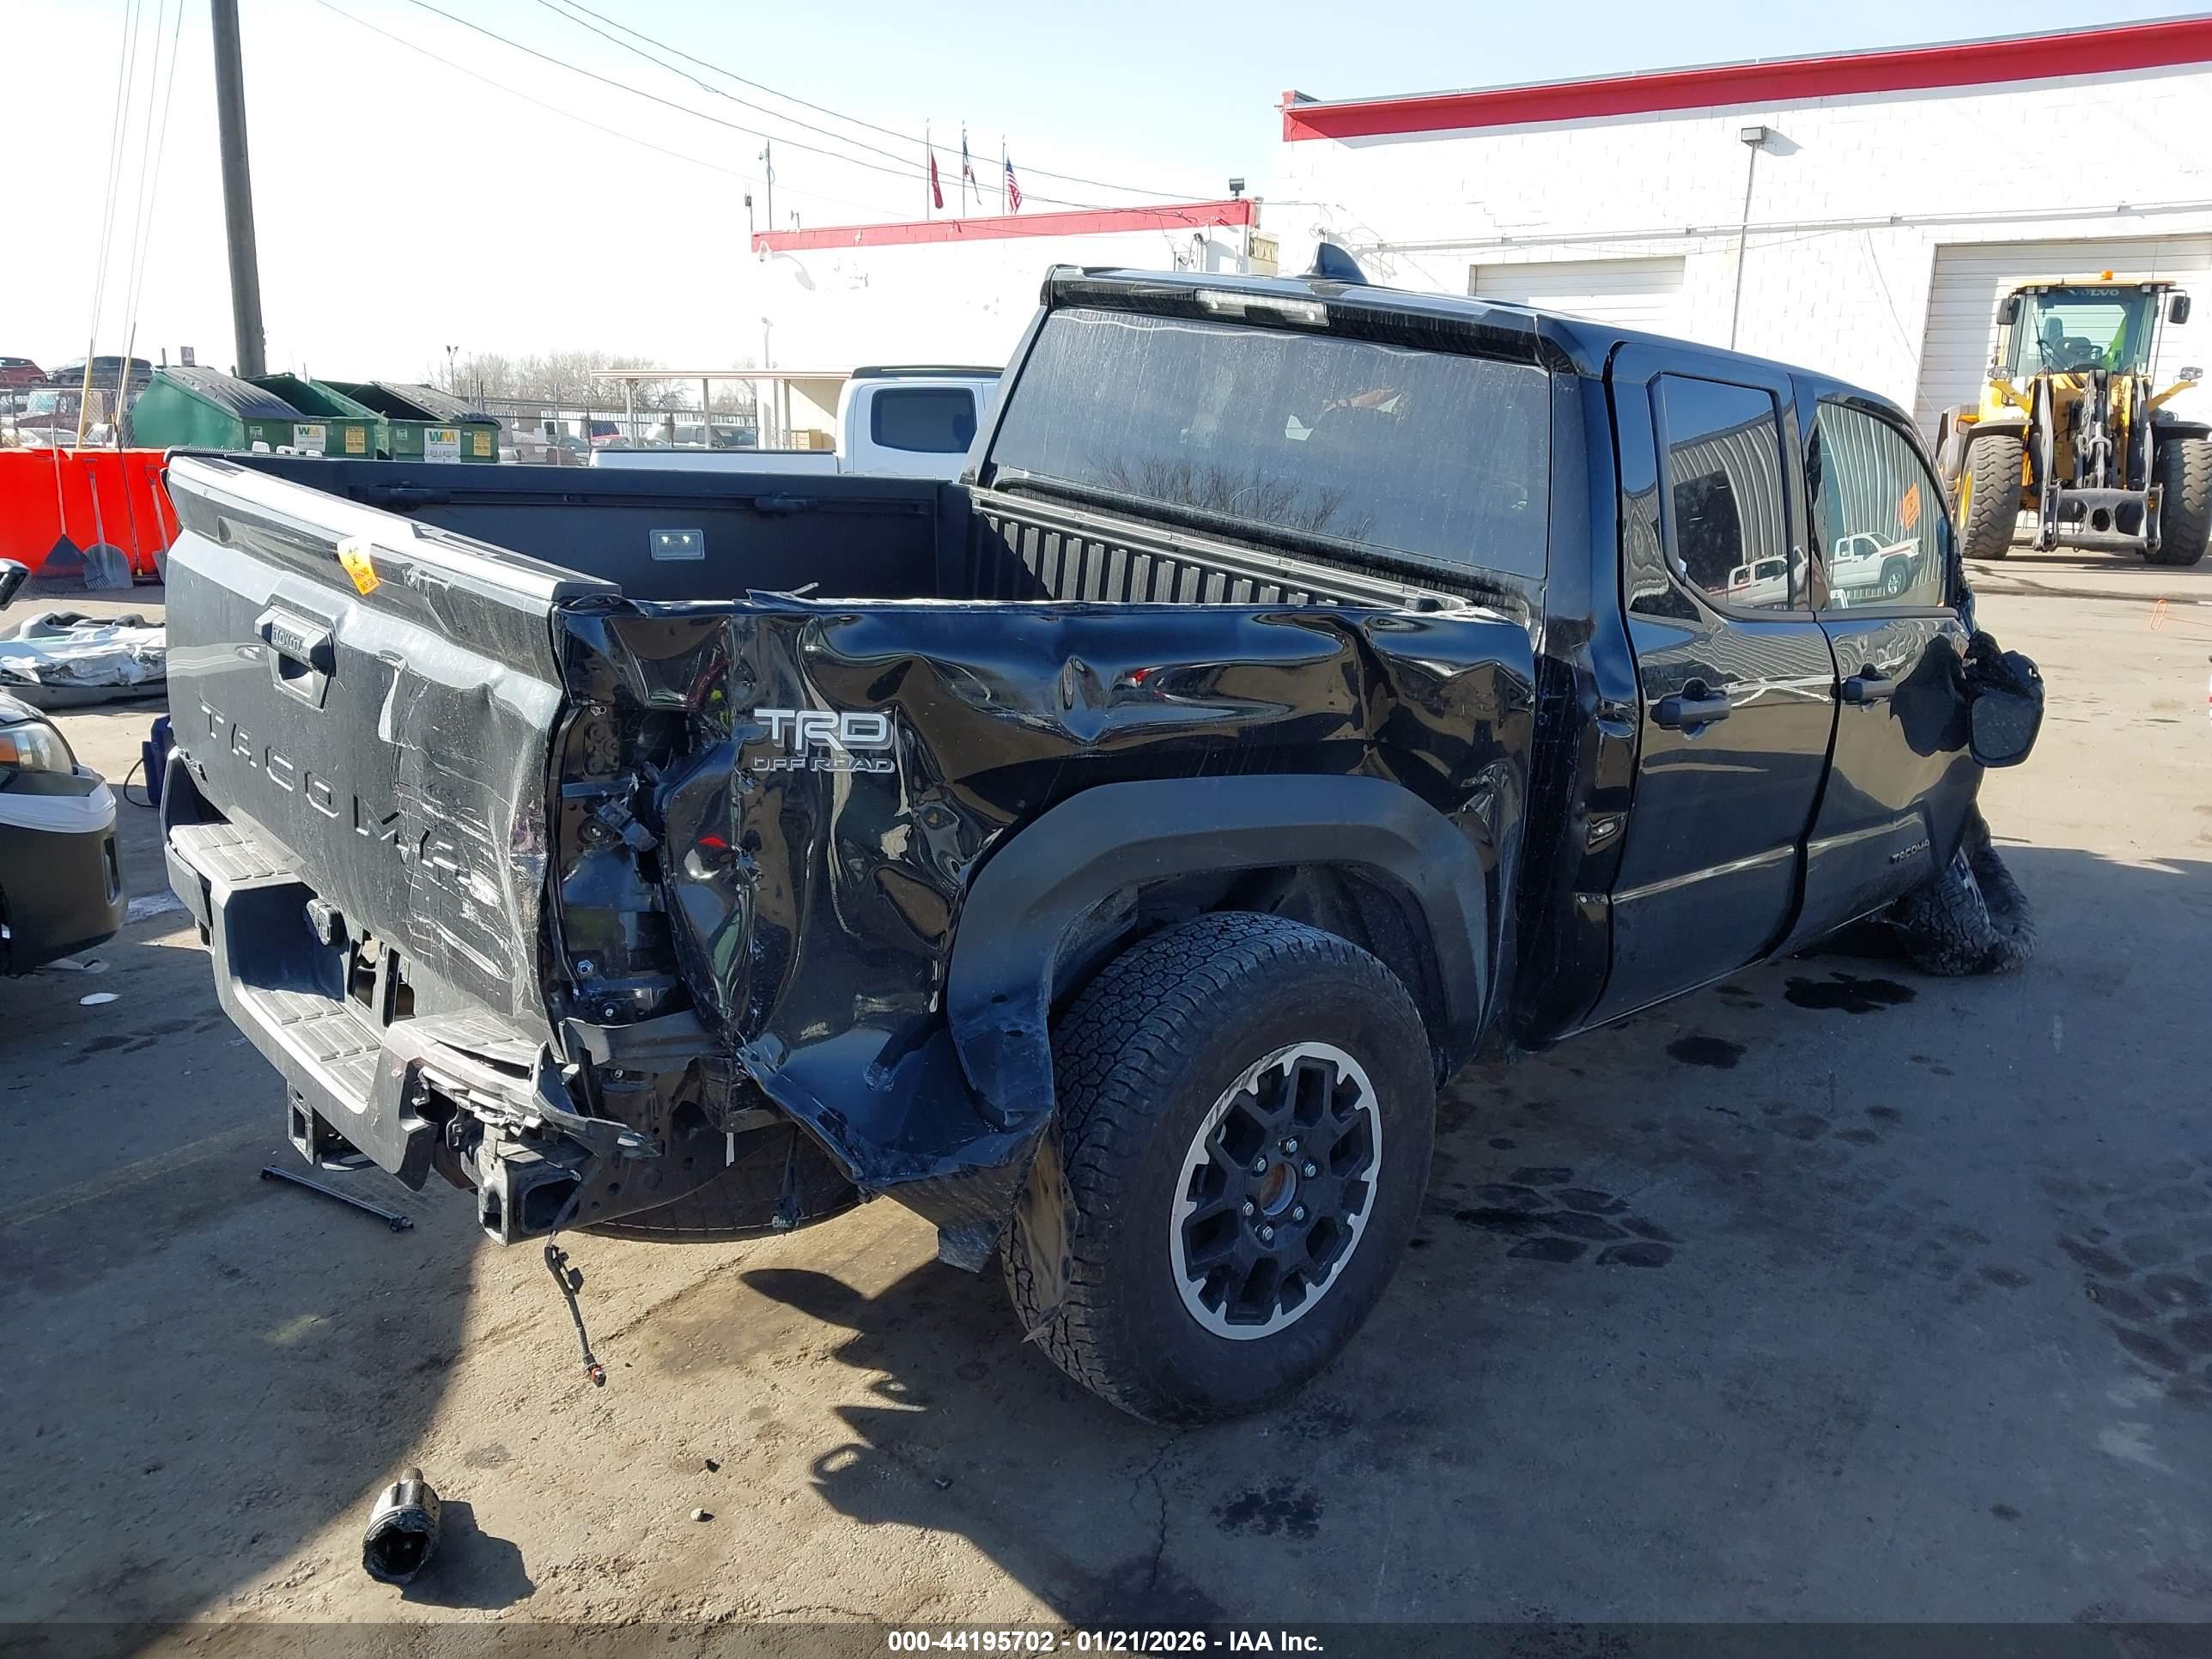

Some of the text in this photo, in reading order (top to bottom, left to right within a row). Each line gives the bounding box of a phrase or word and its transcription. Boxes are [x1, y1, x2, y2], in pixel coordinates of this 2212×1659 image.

[2068, 288, 2120, 296] VOLVO
[429, 430, 456, 442] WM
[273, 626, 304, 653] TOYOTA
[753, 708, 894, 757] TRD
[751, 756, 896, 773] OFF ROAD
[200, 695, 471, 886] TACOMA
